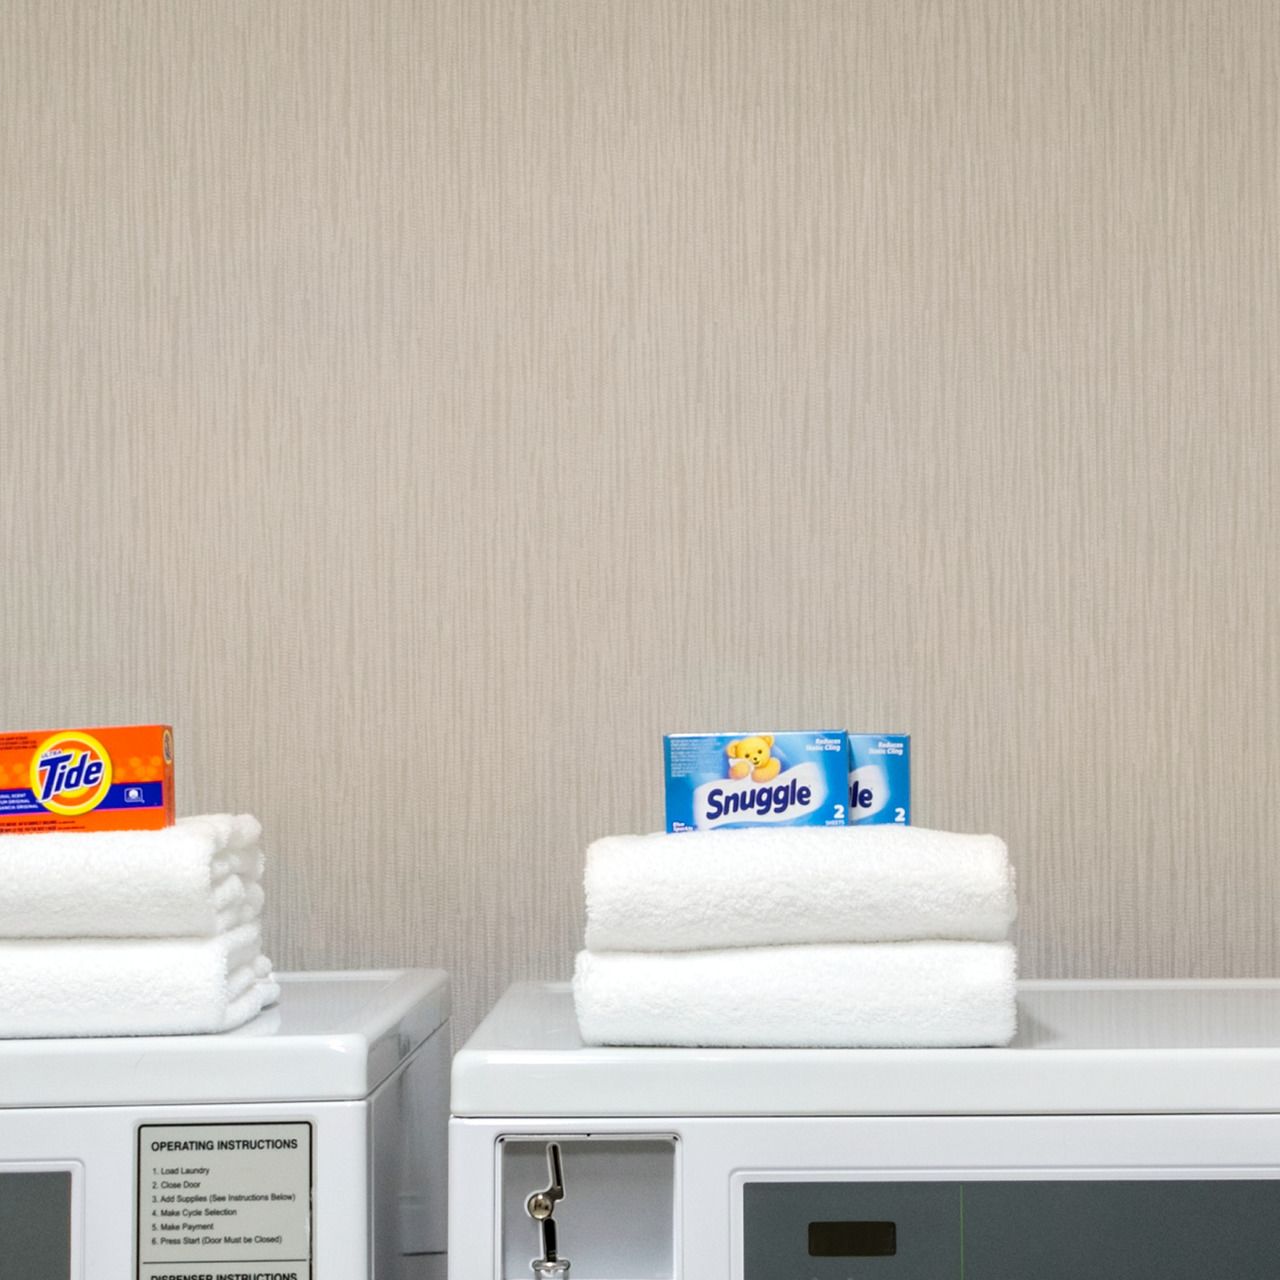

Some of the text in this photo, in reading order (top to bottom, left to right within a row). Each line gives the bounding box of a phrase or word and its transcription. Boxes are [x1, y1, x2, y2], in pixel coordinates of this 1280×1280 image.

[39, 751, 104, 802] Tide
[706, 778, 811, 820] Snuggle
[834, 804, 845, 819] 2
[895, 808, 905, 822] 2
[151, 1139, 298, 1151] OPERATING INSTRUCTIONS
[181, 1167, 209, 1176] Laundry
[177, 1195, 207, 1204] Supplies
[209, 1194, 225, 1203] (See
[271, 1193, 296, 1202] Below)
[183, 1209, 202, 1217] Cycle
[182, 1223, 214, 1232] Payment
[202, 1237, 221, 1246] (Door
[255, 1236, 282, 1244] Closed)
